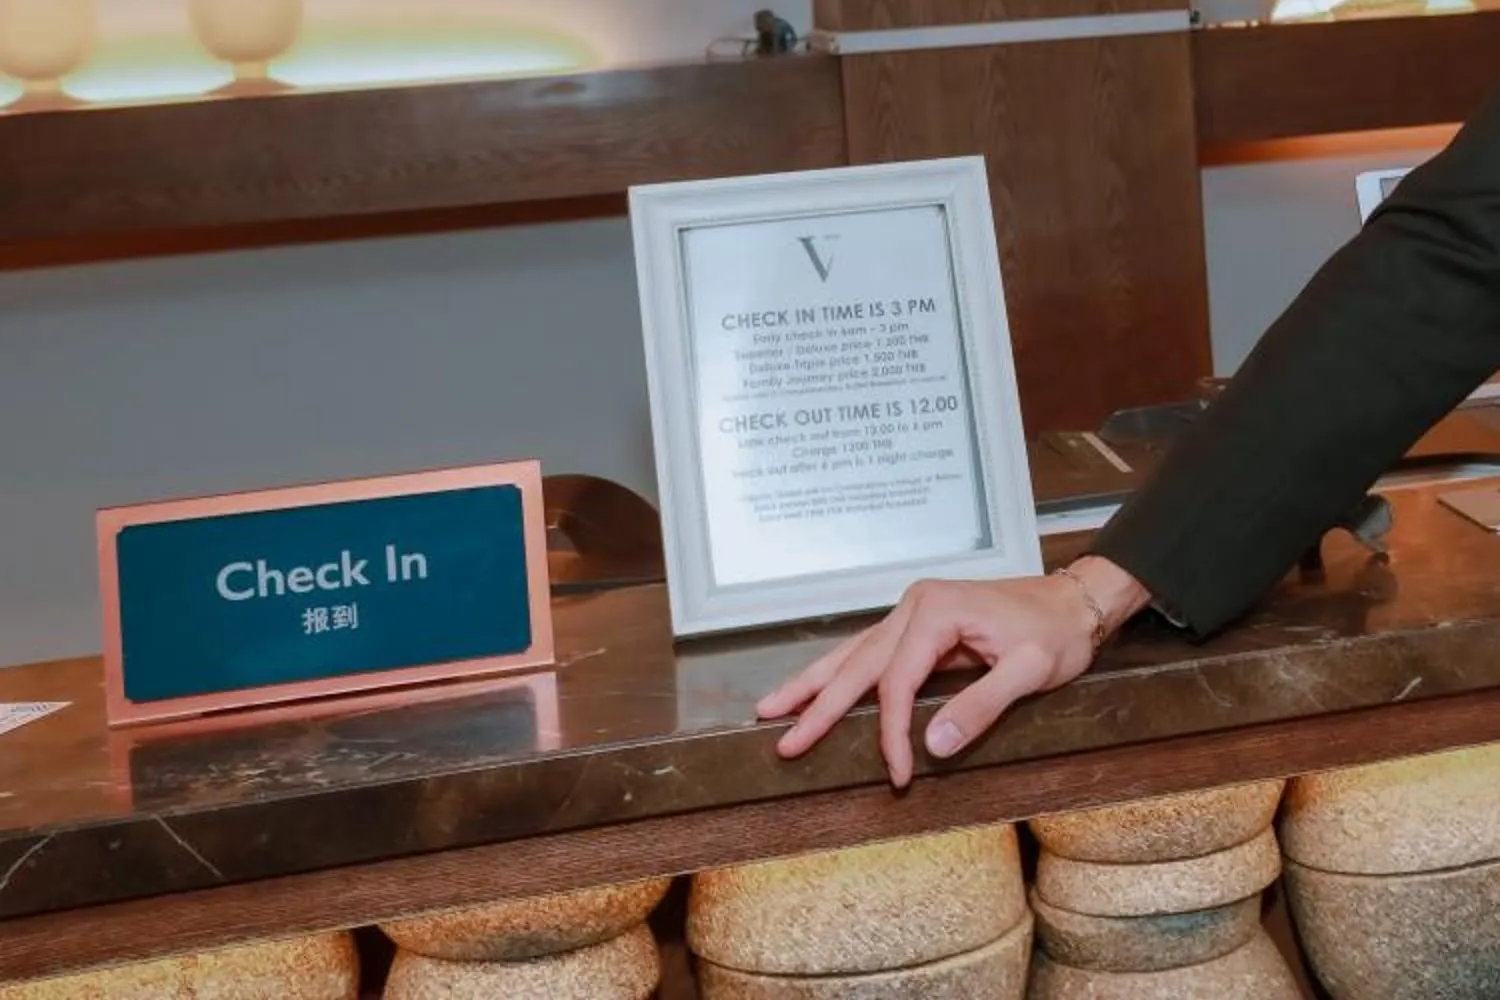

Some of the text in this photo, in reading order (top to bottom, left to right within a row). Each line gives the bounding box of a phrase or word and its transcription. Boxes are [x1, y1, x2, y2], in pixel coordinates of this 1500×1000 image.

[797, 234, 840, 284] V
[721, 297, 936, 331] CHECK IN TIME IS 3 PM
[719, 395, 959, 434] CHECK OUT TIME IS 12.00
[216, 544, 428, 602] Check In
[302, 602, 359, 635] 报到
